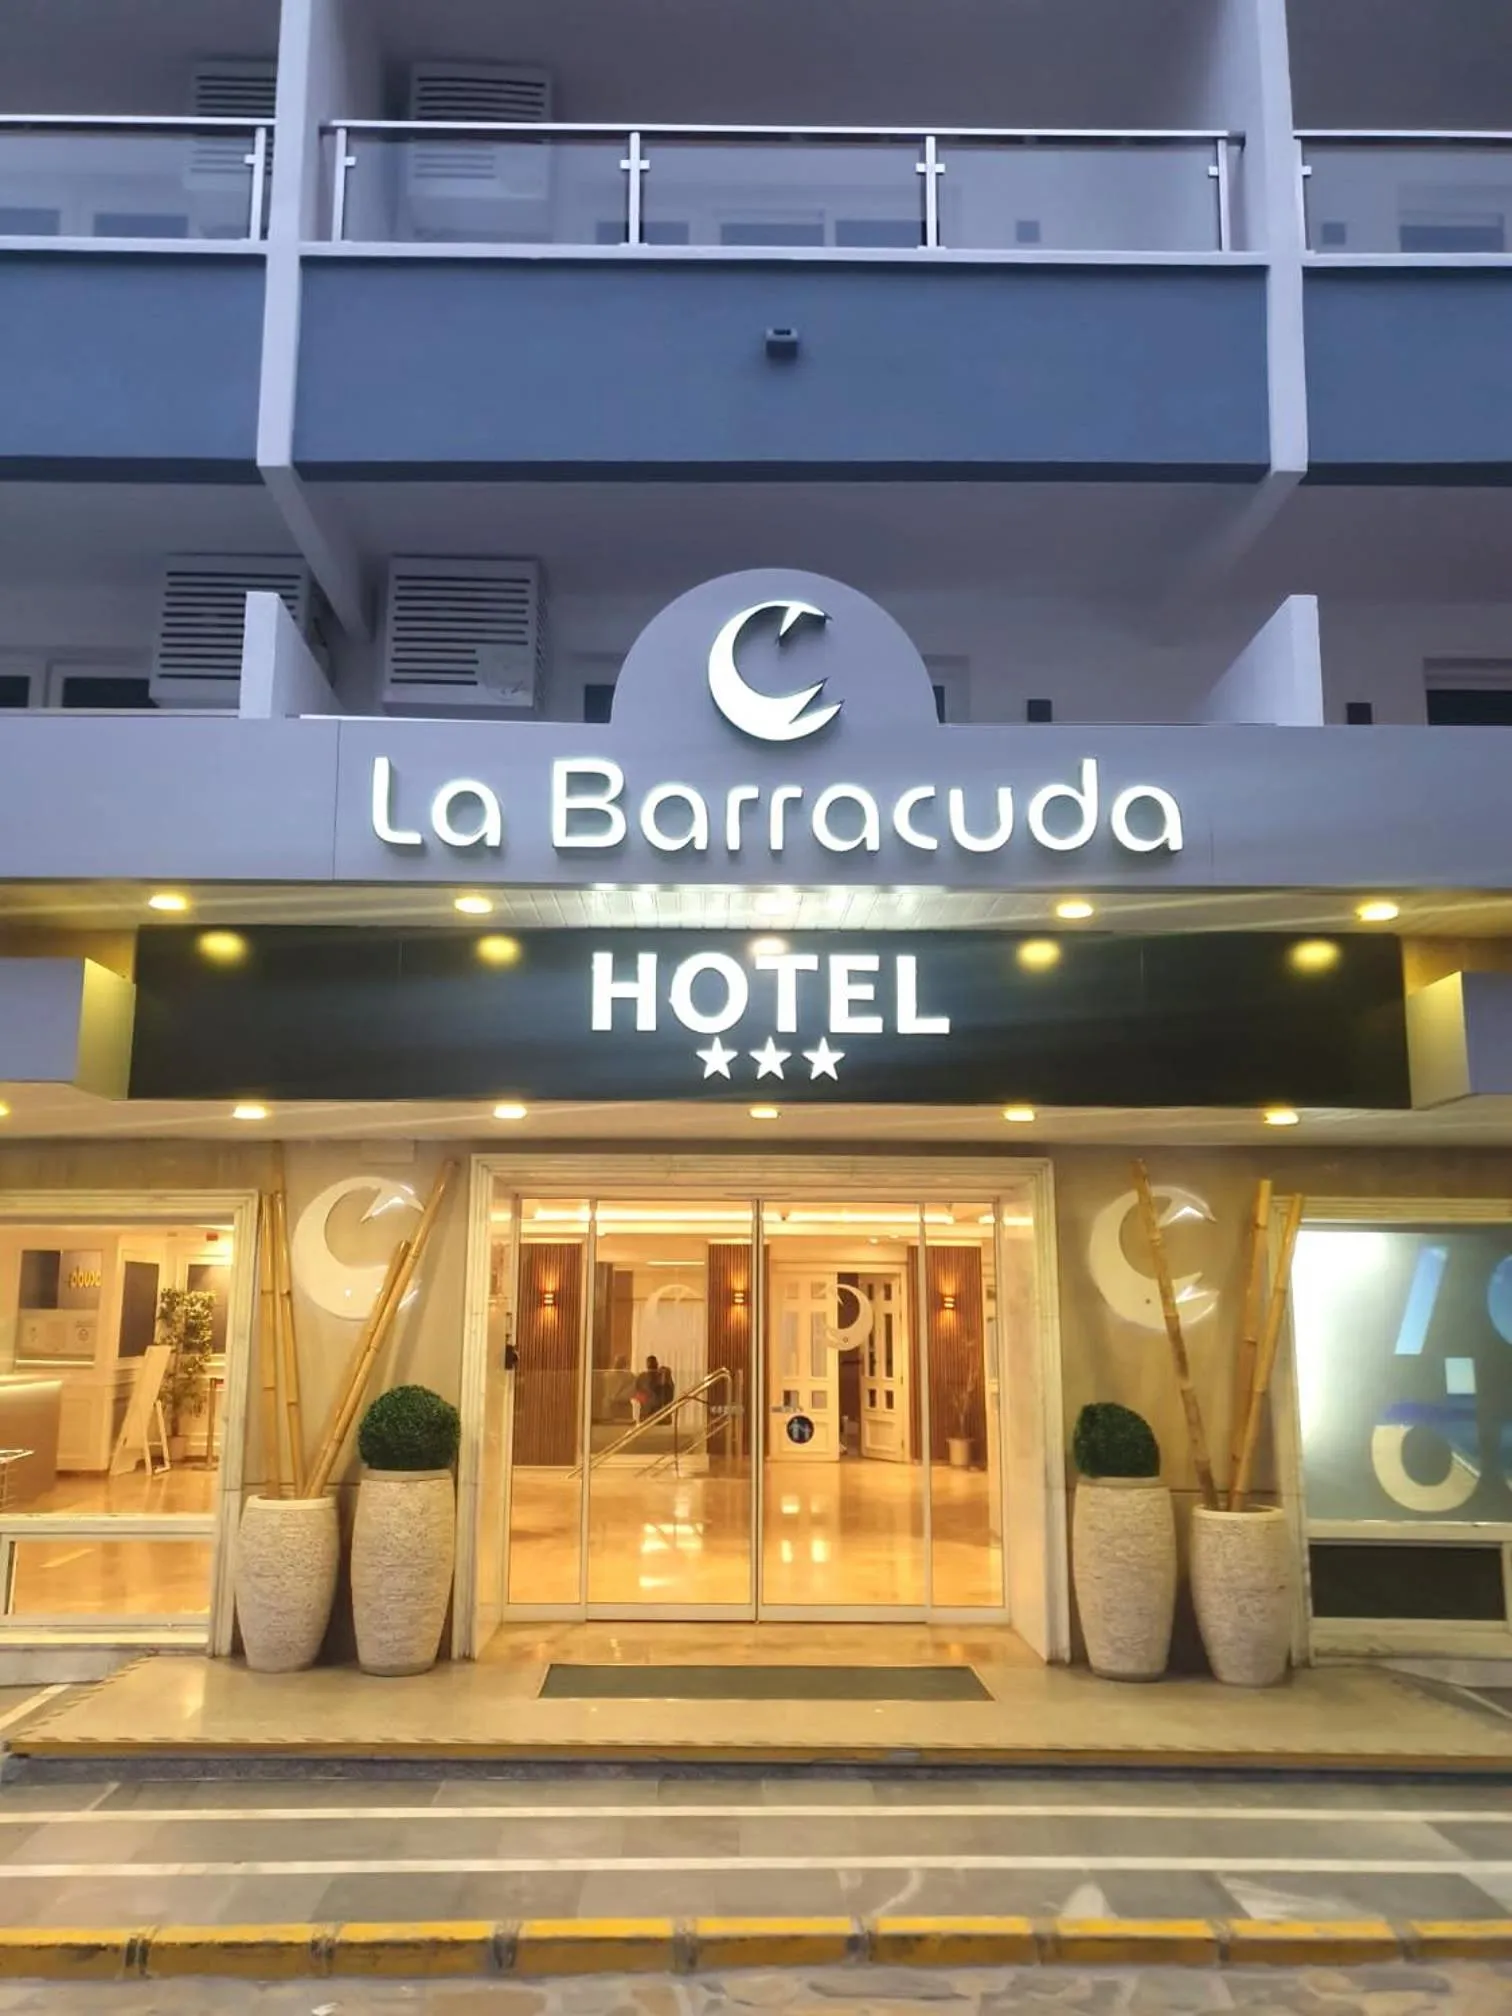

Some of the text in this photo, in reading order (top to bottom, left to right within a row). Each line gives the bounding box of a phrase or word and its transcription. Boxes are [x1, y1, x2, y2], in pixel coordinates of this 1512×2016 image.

[372, 756, 1183, 852] La Barracuda
[591, 951, 951, 1035] HOTEL
